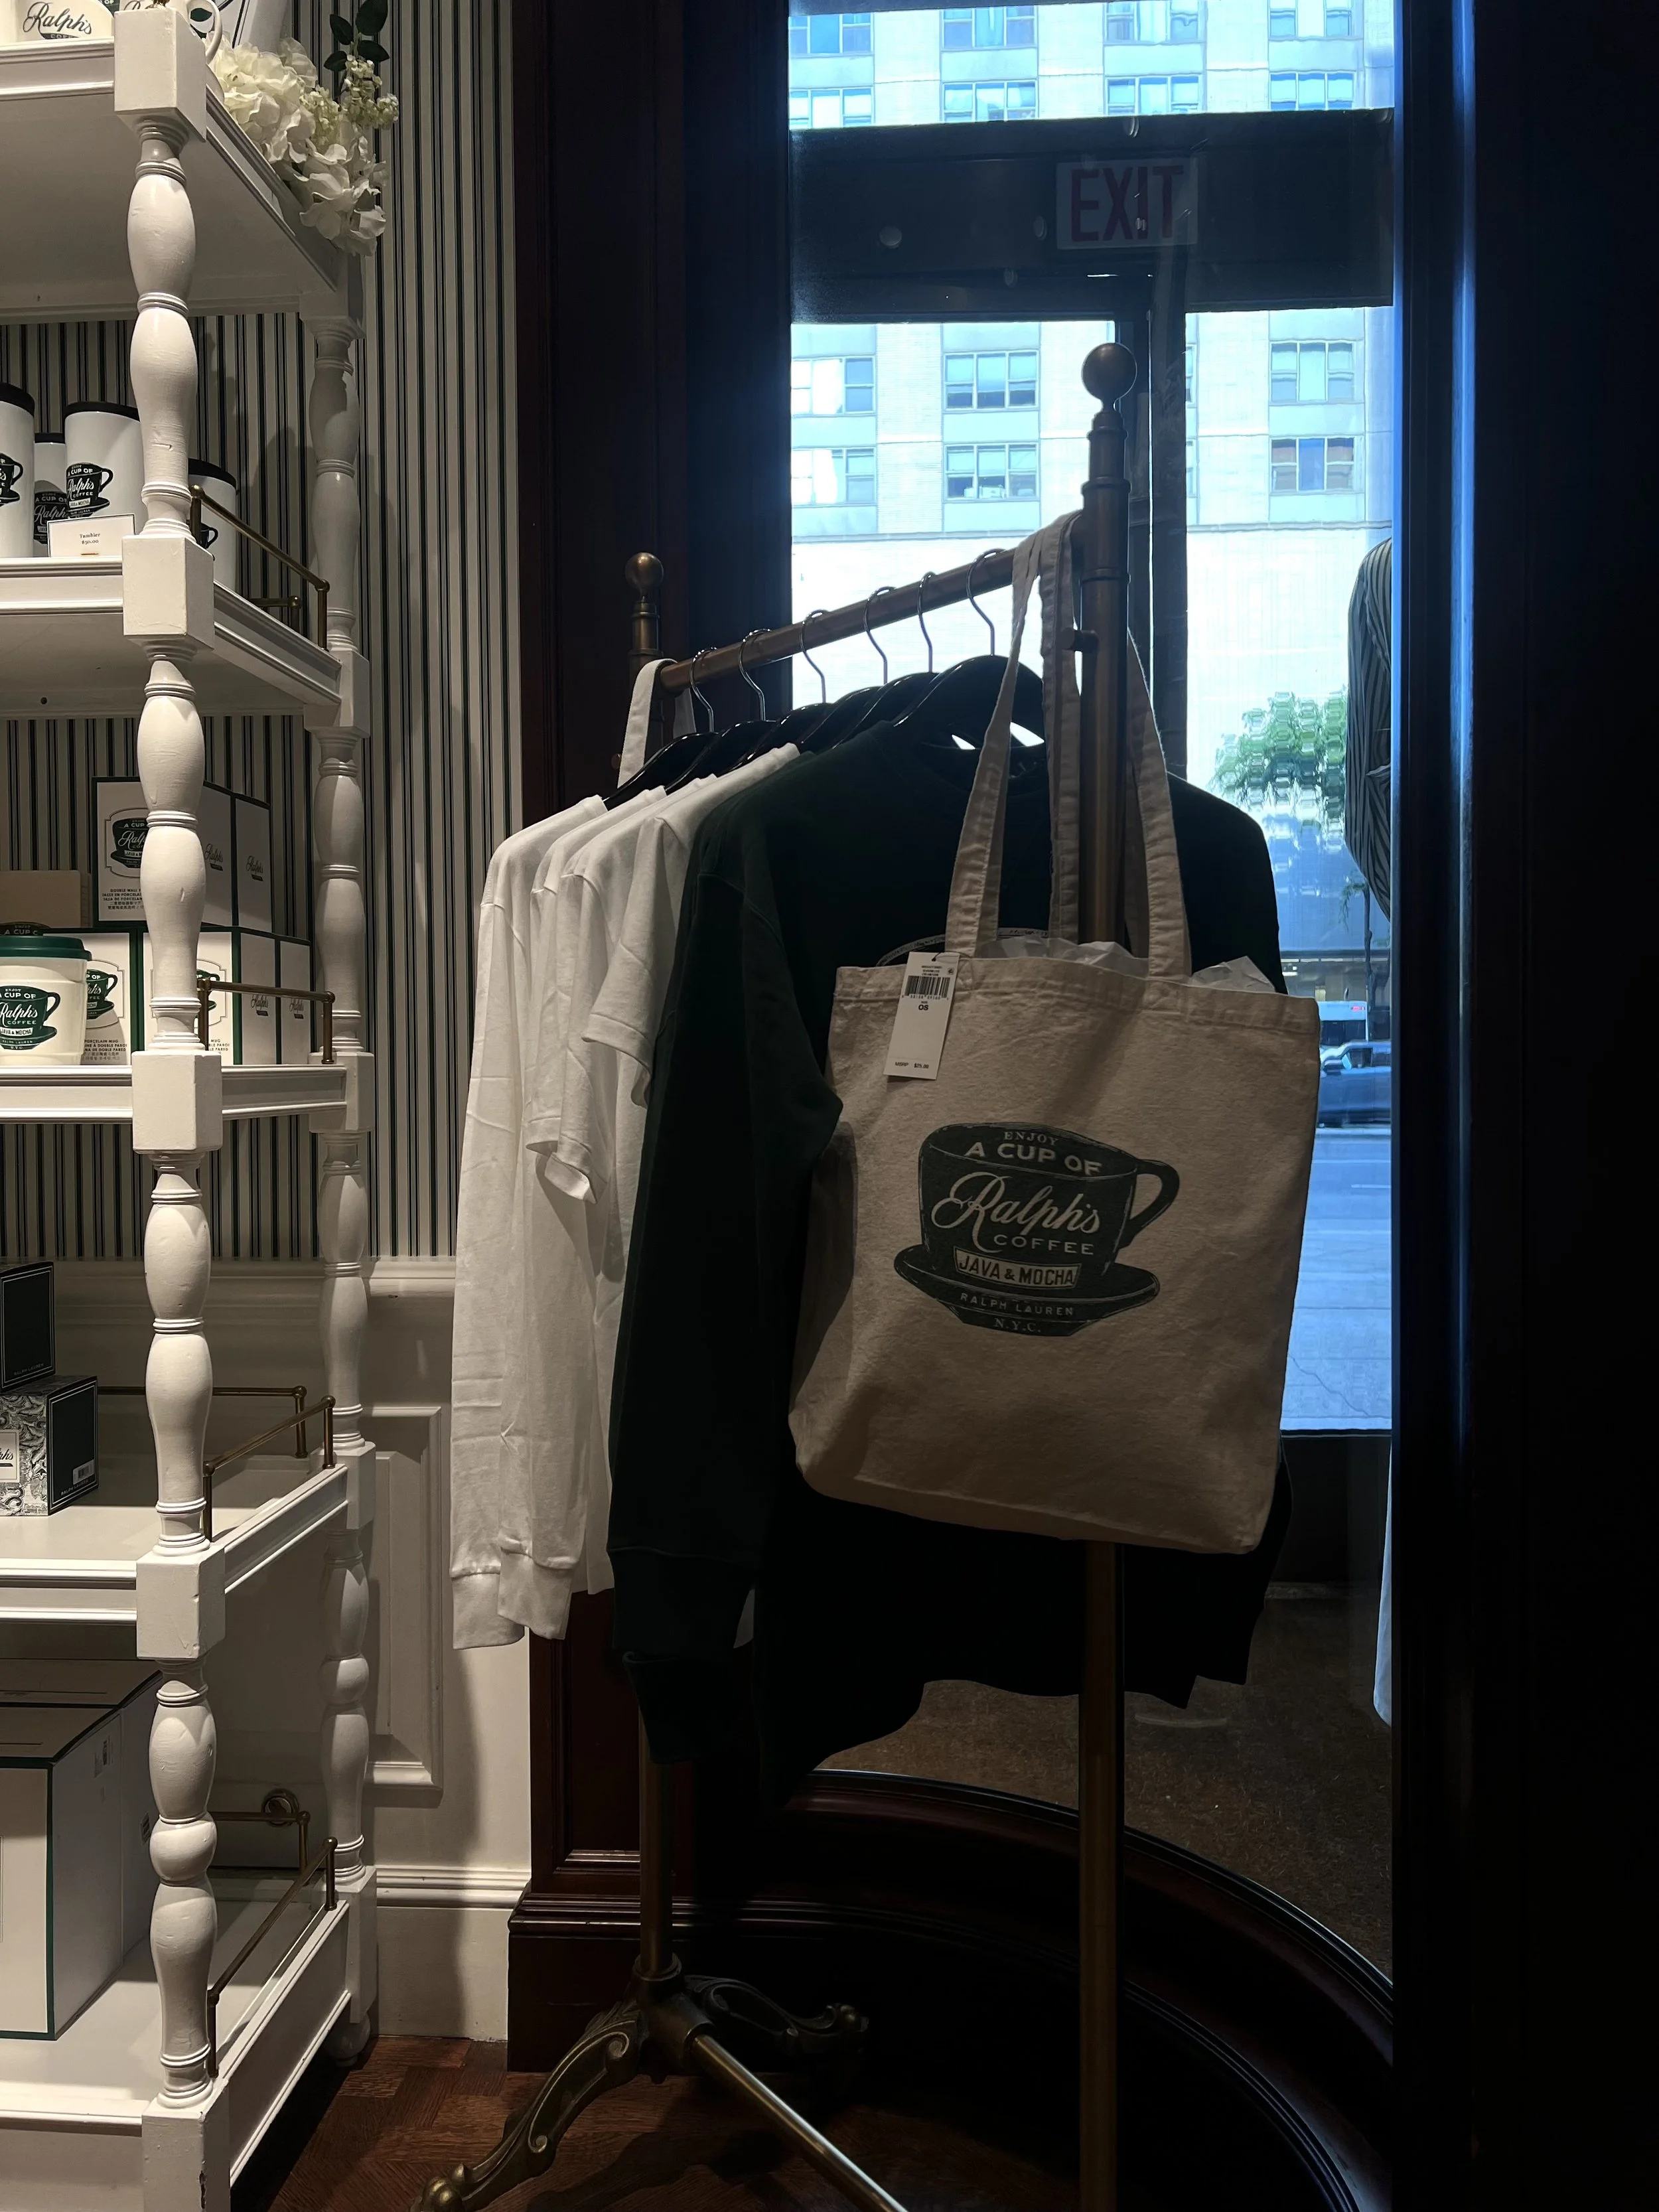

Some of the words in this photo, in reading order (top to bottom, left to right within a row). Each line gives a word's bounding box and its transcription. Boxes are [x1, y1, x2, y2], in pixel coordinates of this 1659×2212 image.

[23, 1, 92, 35] Ralph's
[1070, 165, 1185, 242] EXIT
[67, 478, 94, 501] Ralph's
[0, 1002, 38, 1027] Ralph's
[1003, 1131, 1059, 1147] ENJOY
[964, 1142, 986, 1157] A
[997, 1143, 1056, 1163] CUP
[1064, 1155, 1103, 1176] OF
[931, 1171, 1101, 1253] Ralph's
[993, 1234, 1094, 1255] COFFEE
[959, 1254, 1000, 1280] JAVA
[1004, 1268, 1015, 1281] &
[1019, 1267, 1074, 1286] MOCHA
[960, 1292, 1008, 1311] RALPH
[1015, 1301, 1074, 1316] LAUREN
[994, 1317, 1042, 1334] N.Y.C.
